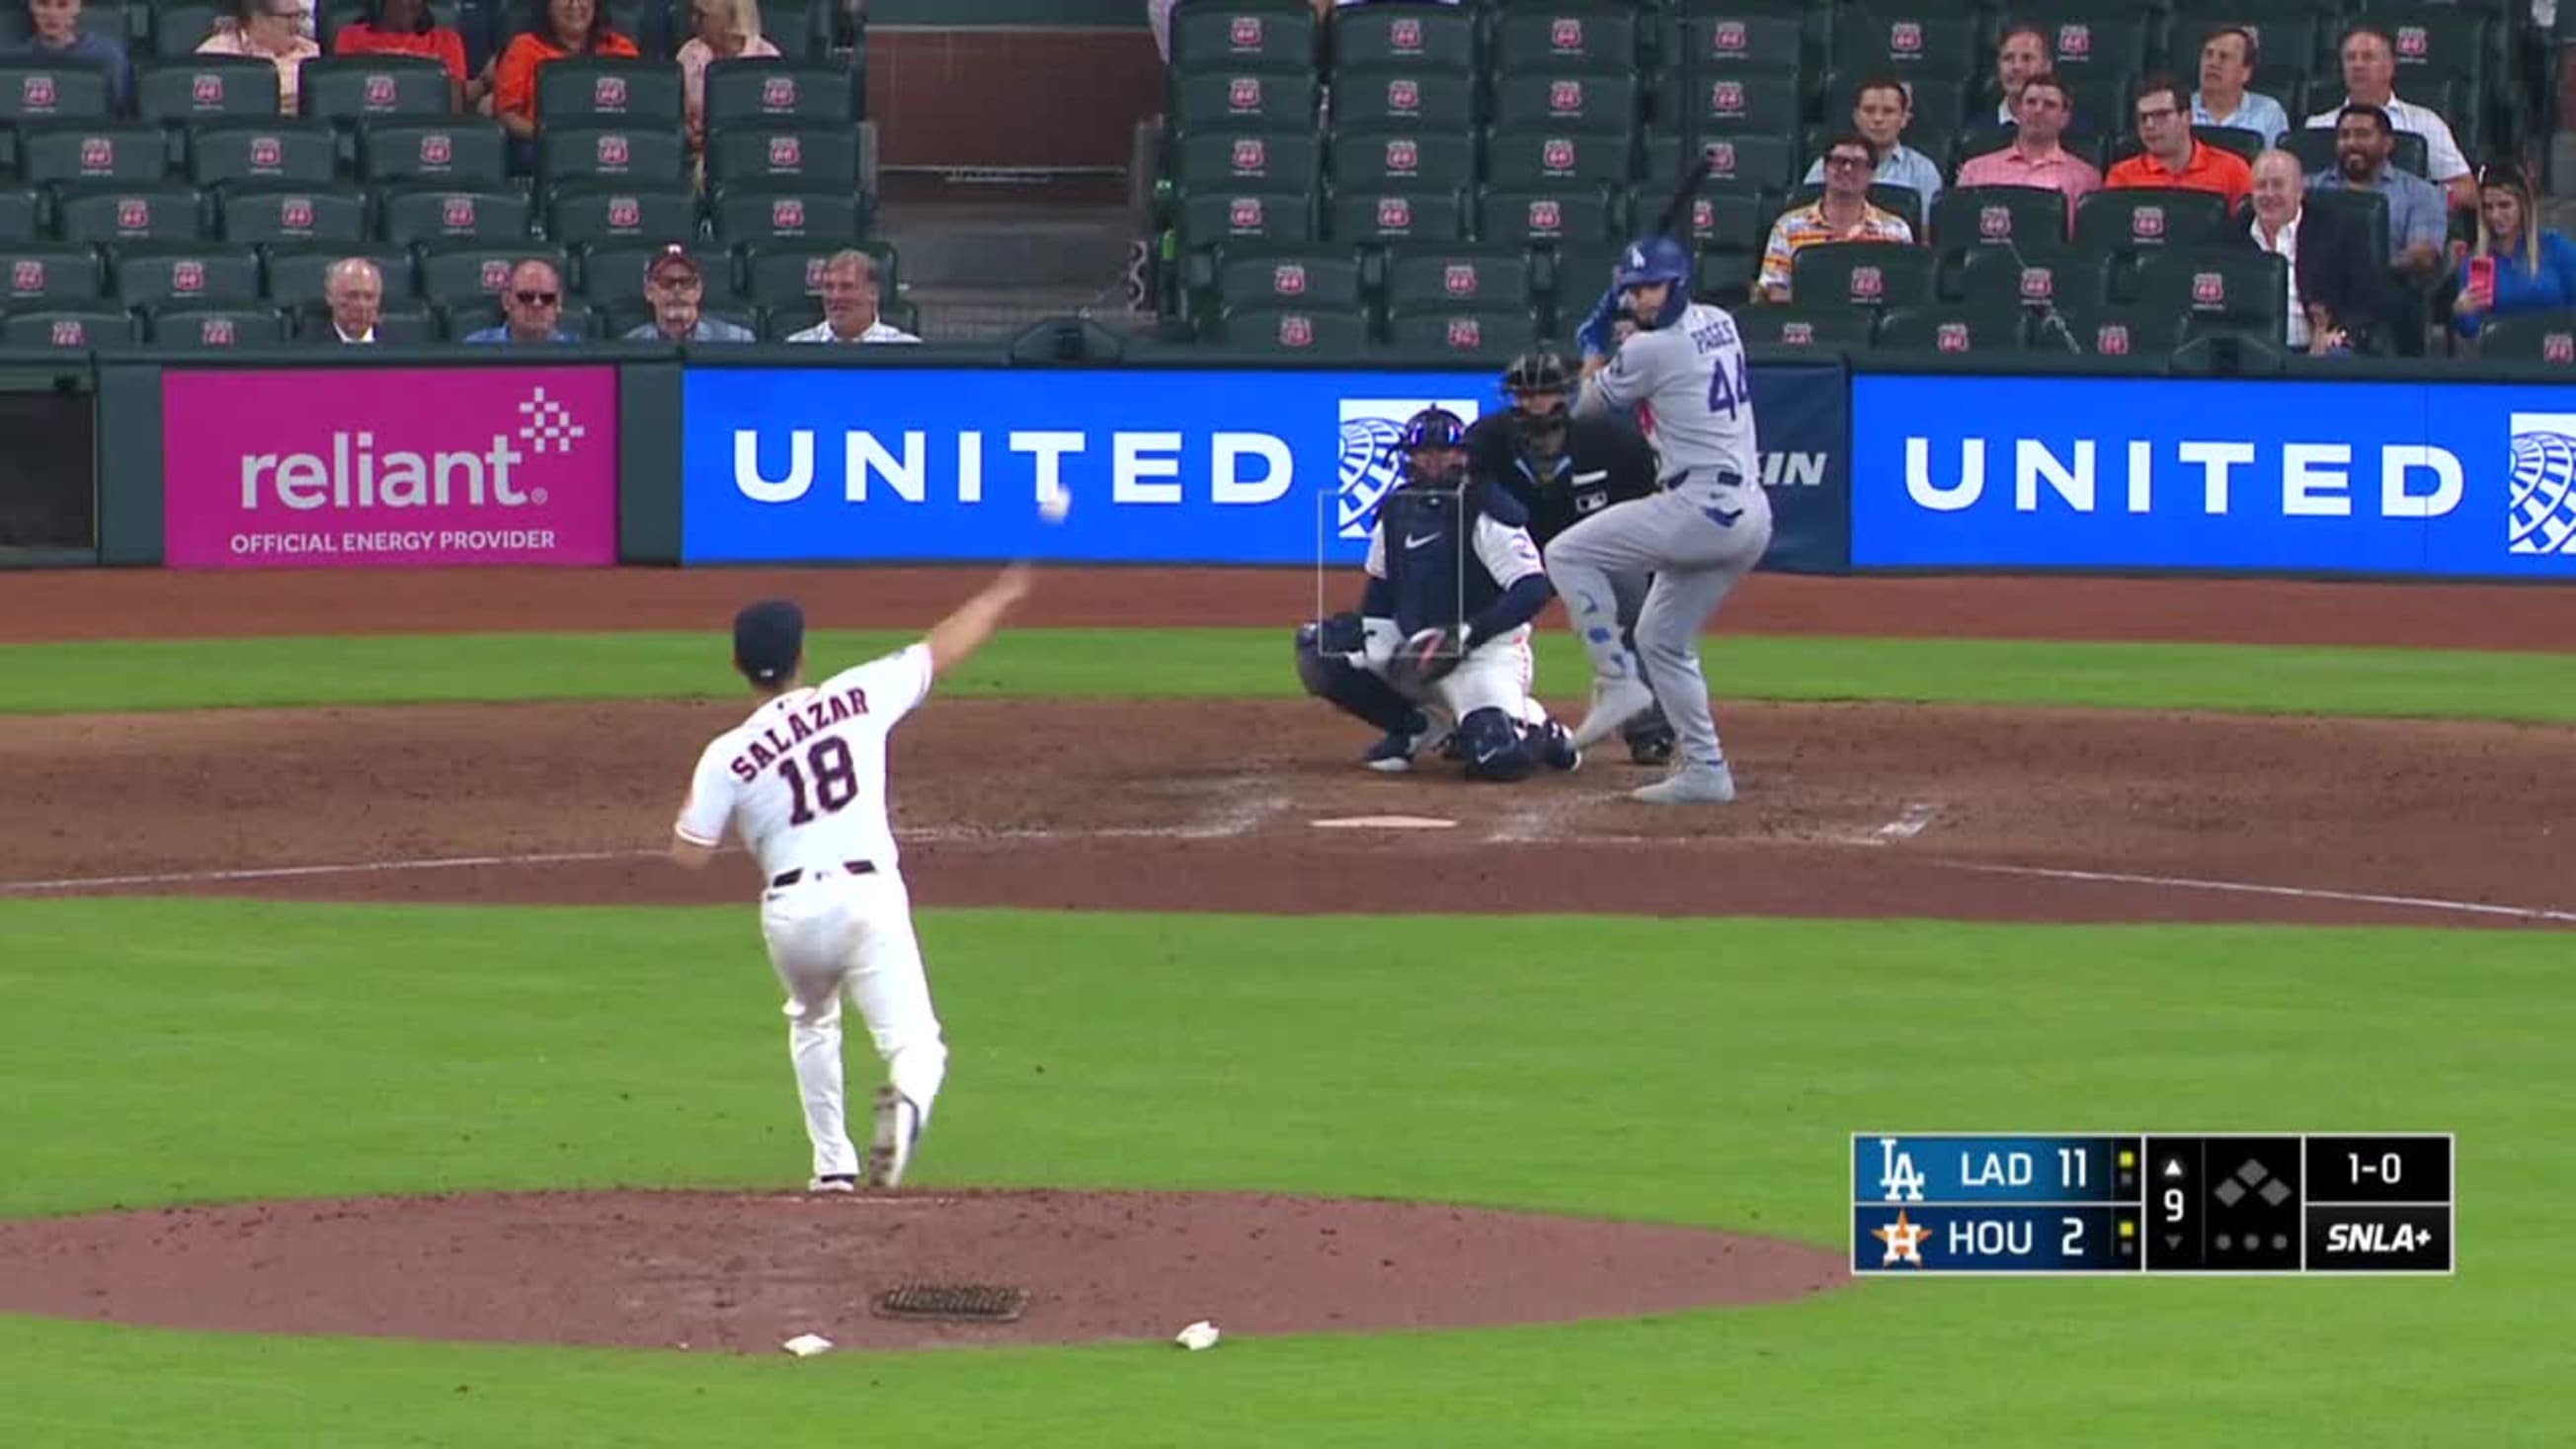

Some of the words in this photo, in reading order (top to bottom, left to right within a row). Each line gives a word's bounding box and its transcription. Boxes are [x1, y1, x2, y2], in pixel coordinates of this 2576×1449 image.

[242, 432, 527, 508] reliant
[734, 430, 1294, 504] UNITED
[1762, 451, 1826, 485] IN
[1904, 437, 2463, 517] UNITED
[230, 533, 338, 554] OFFICIAL
[343, 530, 435, 552] ENERGY
[441, 529, 555, 550] PROVIDER
[731, 687, 869, 783] SALAZAR
[778, 735, 858, 826] 18
